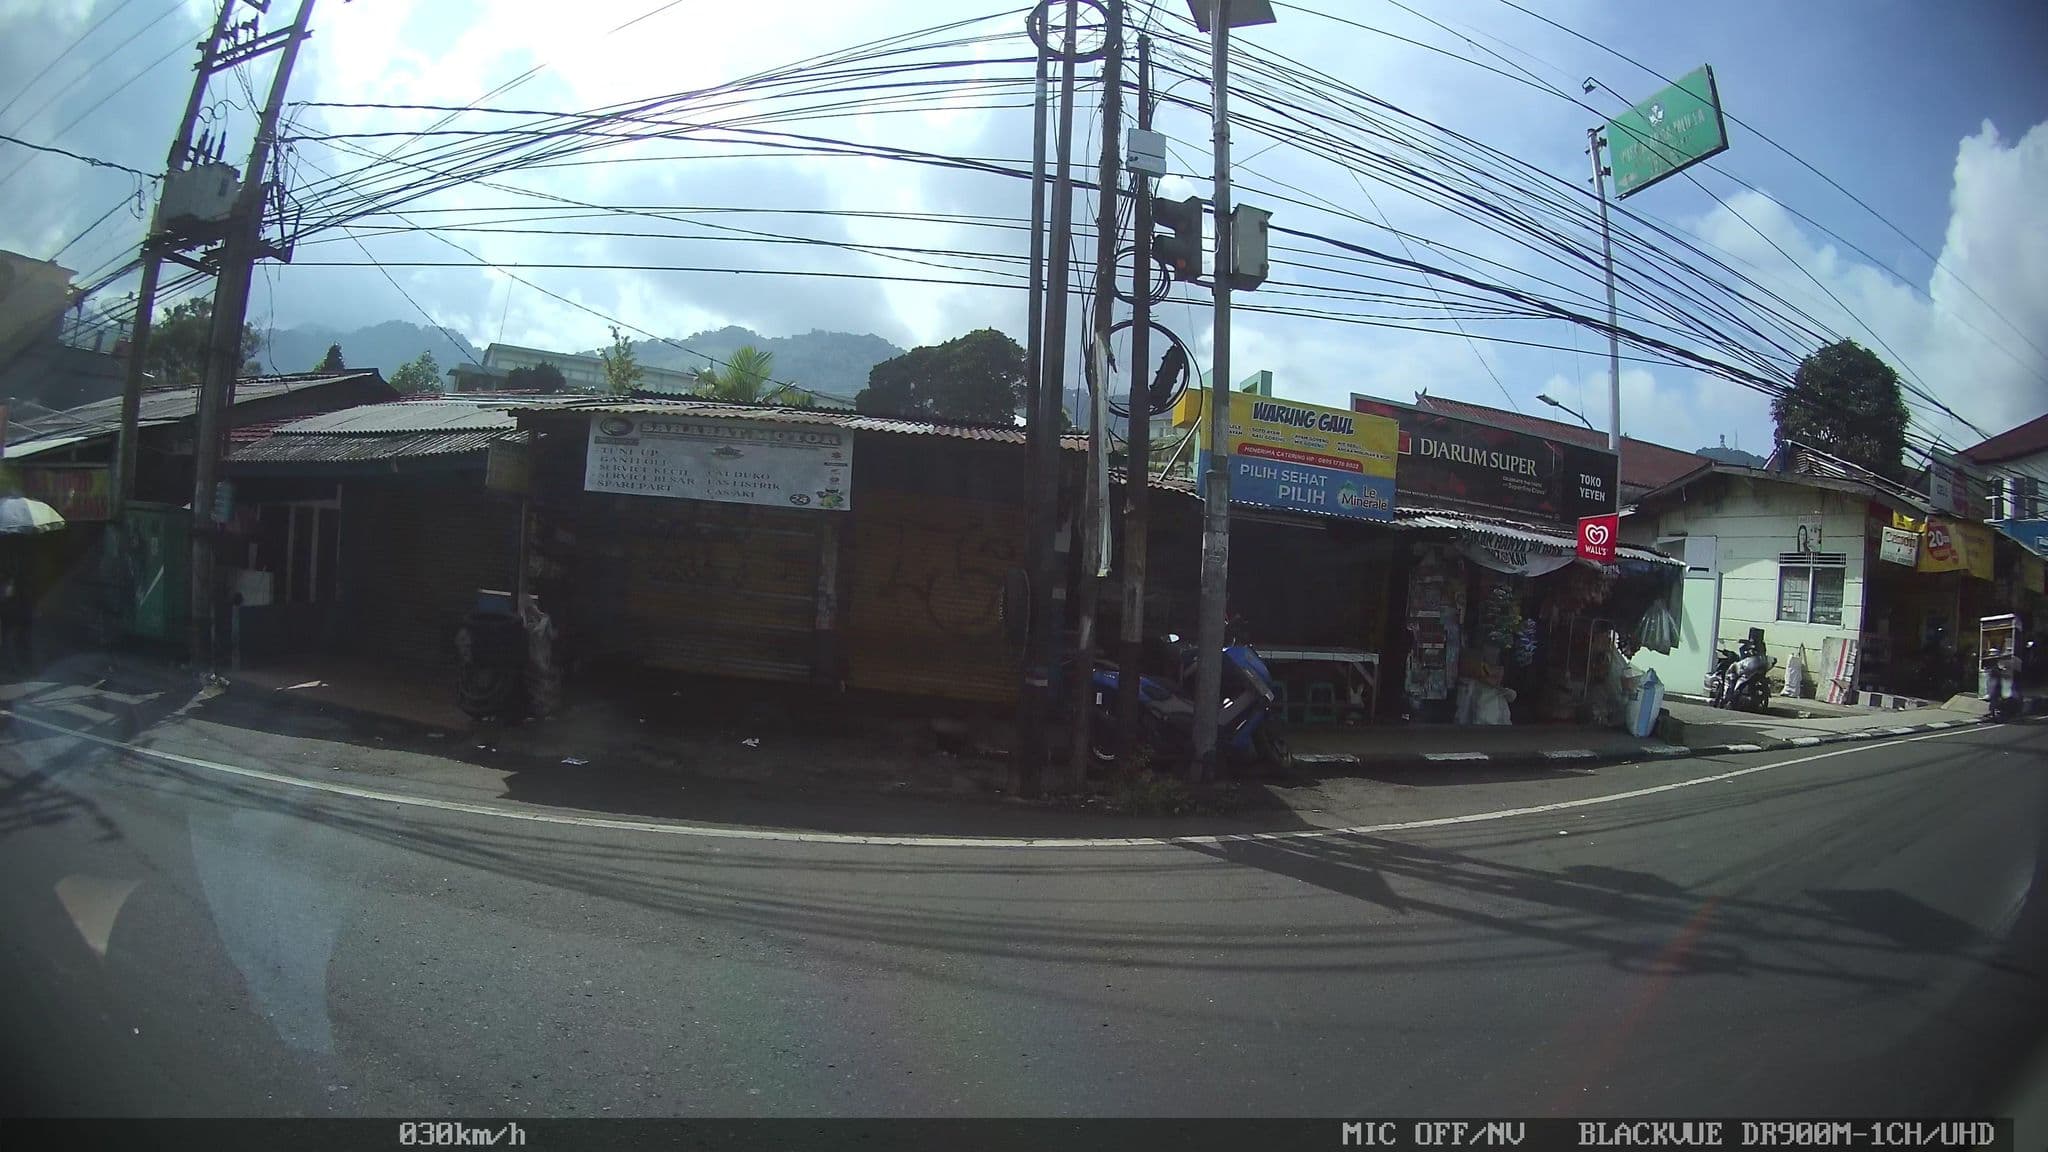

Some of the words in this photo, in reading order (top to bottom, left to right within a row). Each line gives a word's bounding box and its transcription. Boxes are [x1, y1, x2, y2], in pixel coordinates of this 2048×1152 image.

[1253, 402, 1316, 428] WARUNG
[1318, 414, 1354, 434] GAUL
[1244, 447, 1275, 456] MENERIMA
[1276, 451, 1305, 460] CATERING
[1420, 438, 1487, 466] DJARUM
[1490, 452, 1537, 476] SUPER
[600, 464, 646, 473] SERVICE
[1240, 464, 1277, 480] PILIH
[1281, 470, 1328, 486] SEHAT
[600, 473, 646, 482] SERVICE
[1580, 474, 1601, 488] TOKO
[1278, 484, 1325, 504] PILIH
[1363, 485, 1377, 498] Le
[1579, 487, 1606, 502] YEYEN
[1342, 494, 1388, 510] Minerale
[1584, 544, 1606, 556] WALL'S
